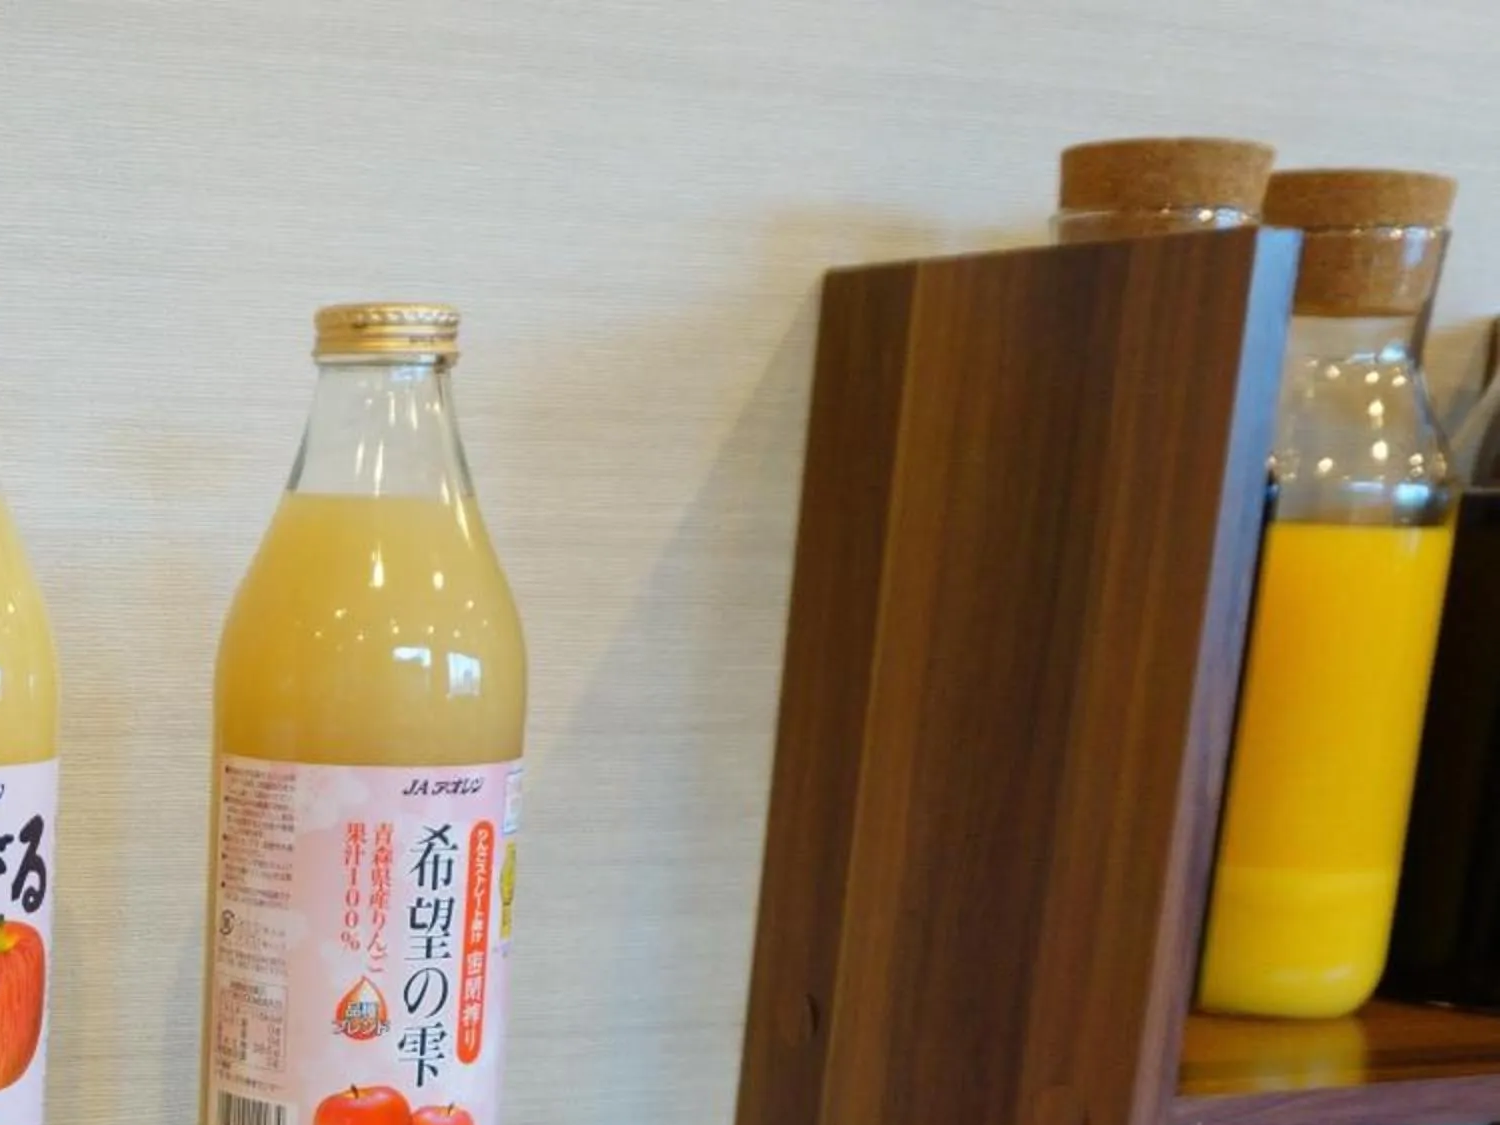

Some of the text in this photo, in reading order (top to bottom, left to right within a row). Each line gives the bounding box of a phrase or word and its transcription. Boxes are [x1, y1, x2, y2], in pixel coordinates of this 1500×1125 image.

[366, 822, 395, 974] 青森県産りんご
[398, 822, 459, 1088] 希望の雫
